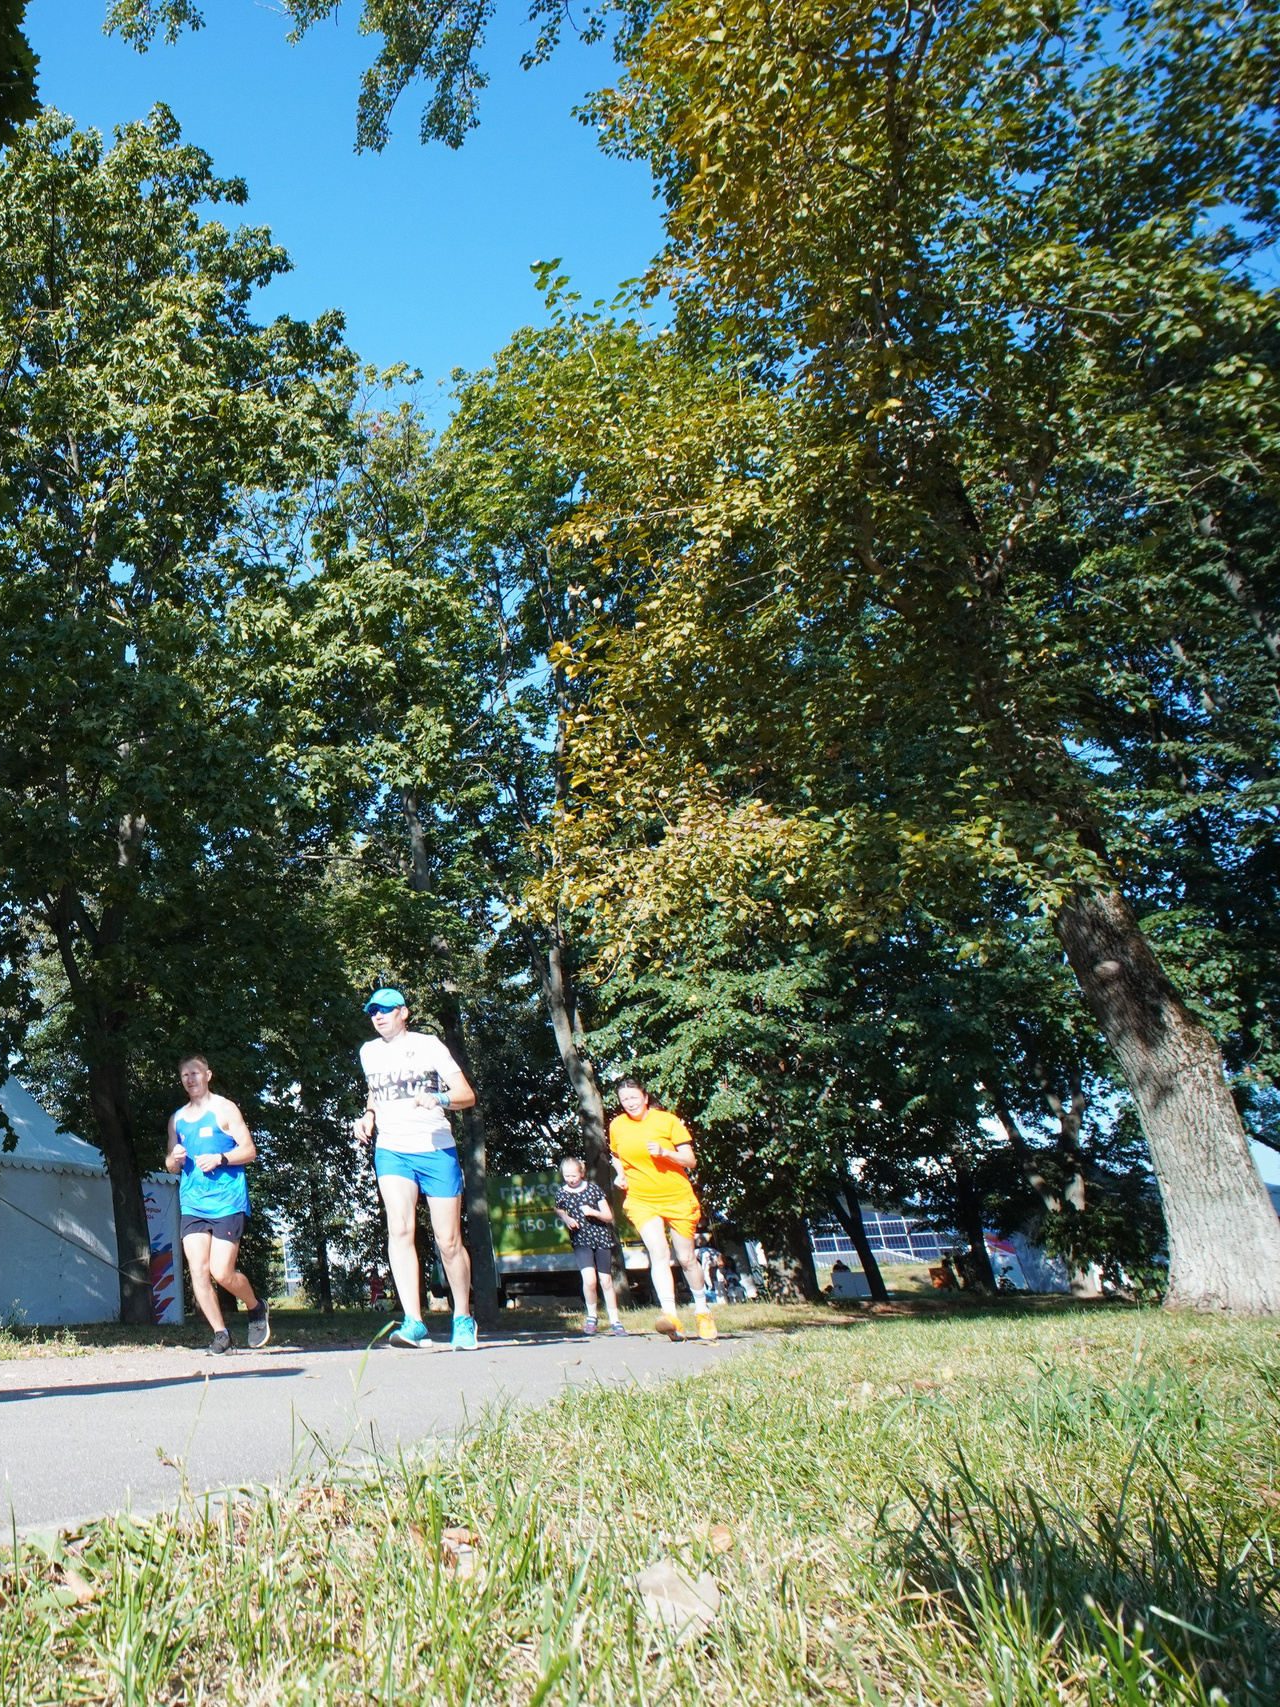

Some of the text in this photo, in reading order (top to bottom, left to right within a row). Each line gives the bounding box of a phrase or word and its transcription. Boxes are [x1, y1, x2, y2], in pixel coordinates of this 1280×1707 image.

[373, 1085, 399, 1102] IVE
[500, 1183, 561, 1203] грузо
[521, 1218, 564, 1232] 150-0
